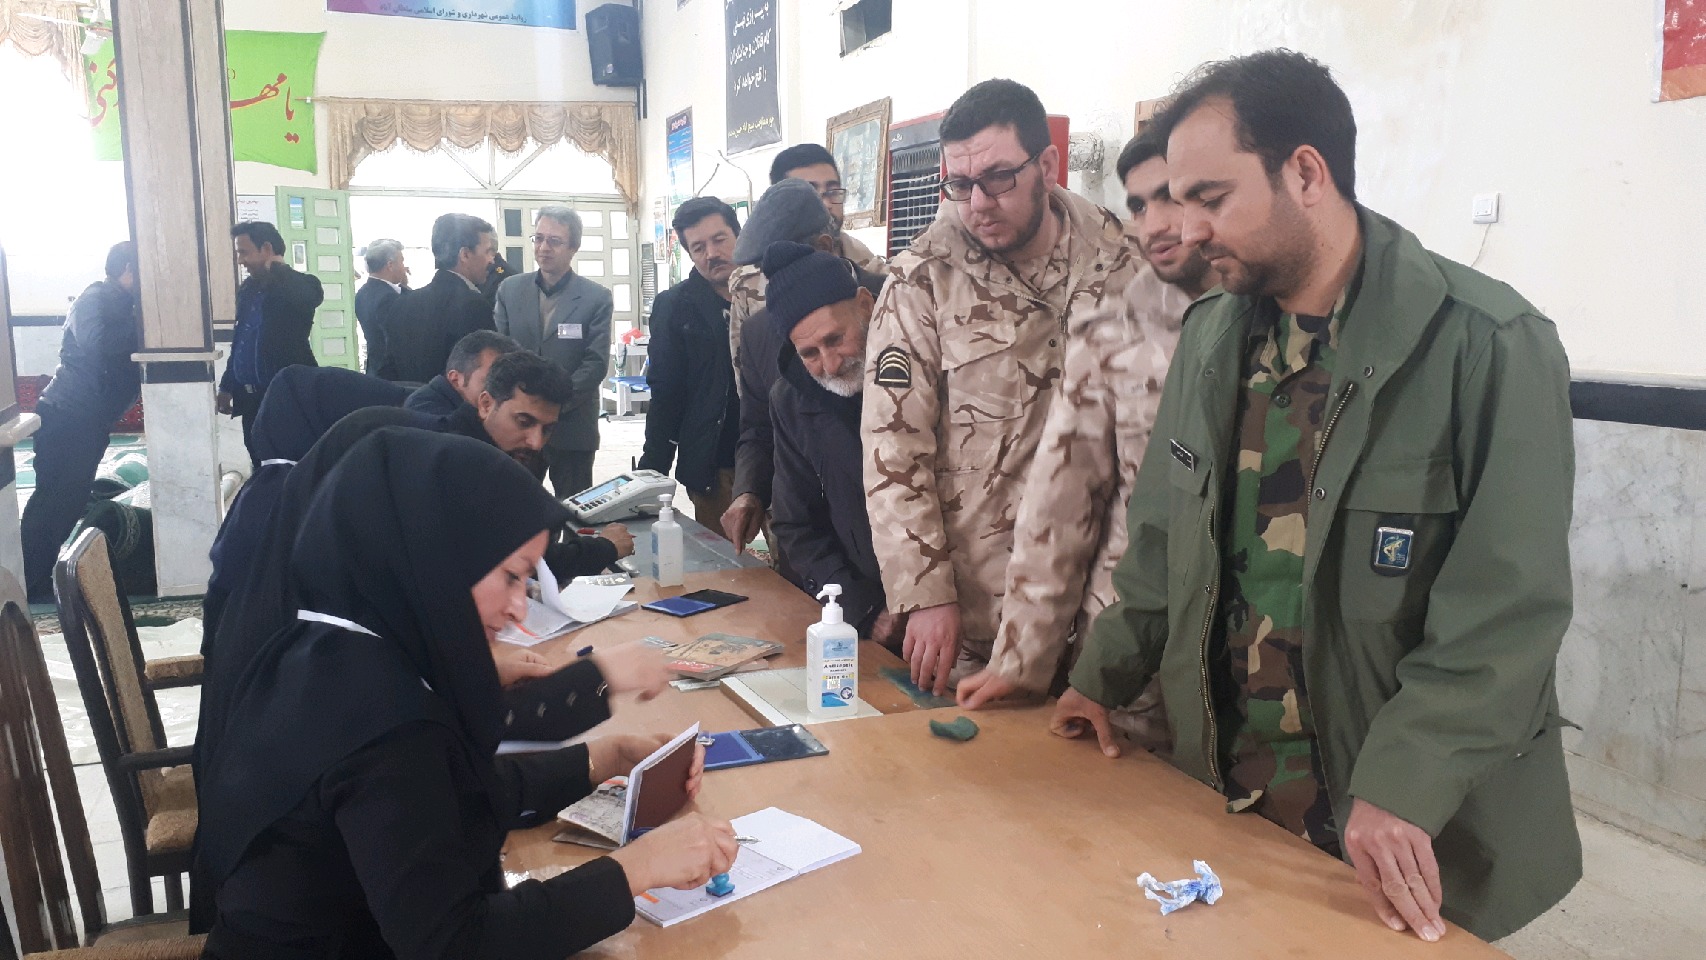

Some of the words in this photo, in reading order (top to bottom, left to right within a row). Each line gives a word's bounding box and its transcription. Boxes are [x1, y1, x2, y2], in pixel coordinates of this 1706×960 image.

[436, 8, 456, 17] شورای
[462, 10, 488, 20] شهرداری
[230, 72, 288, 110] مه
[284, 86, 300, 144] یا
